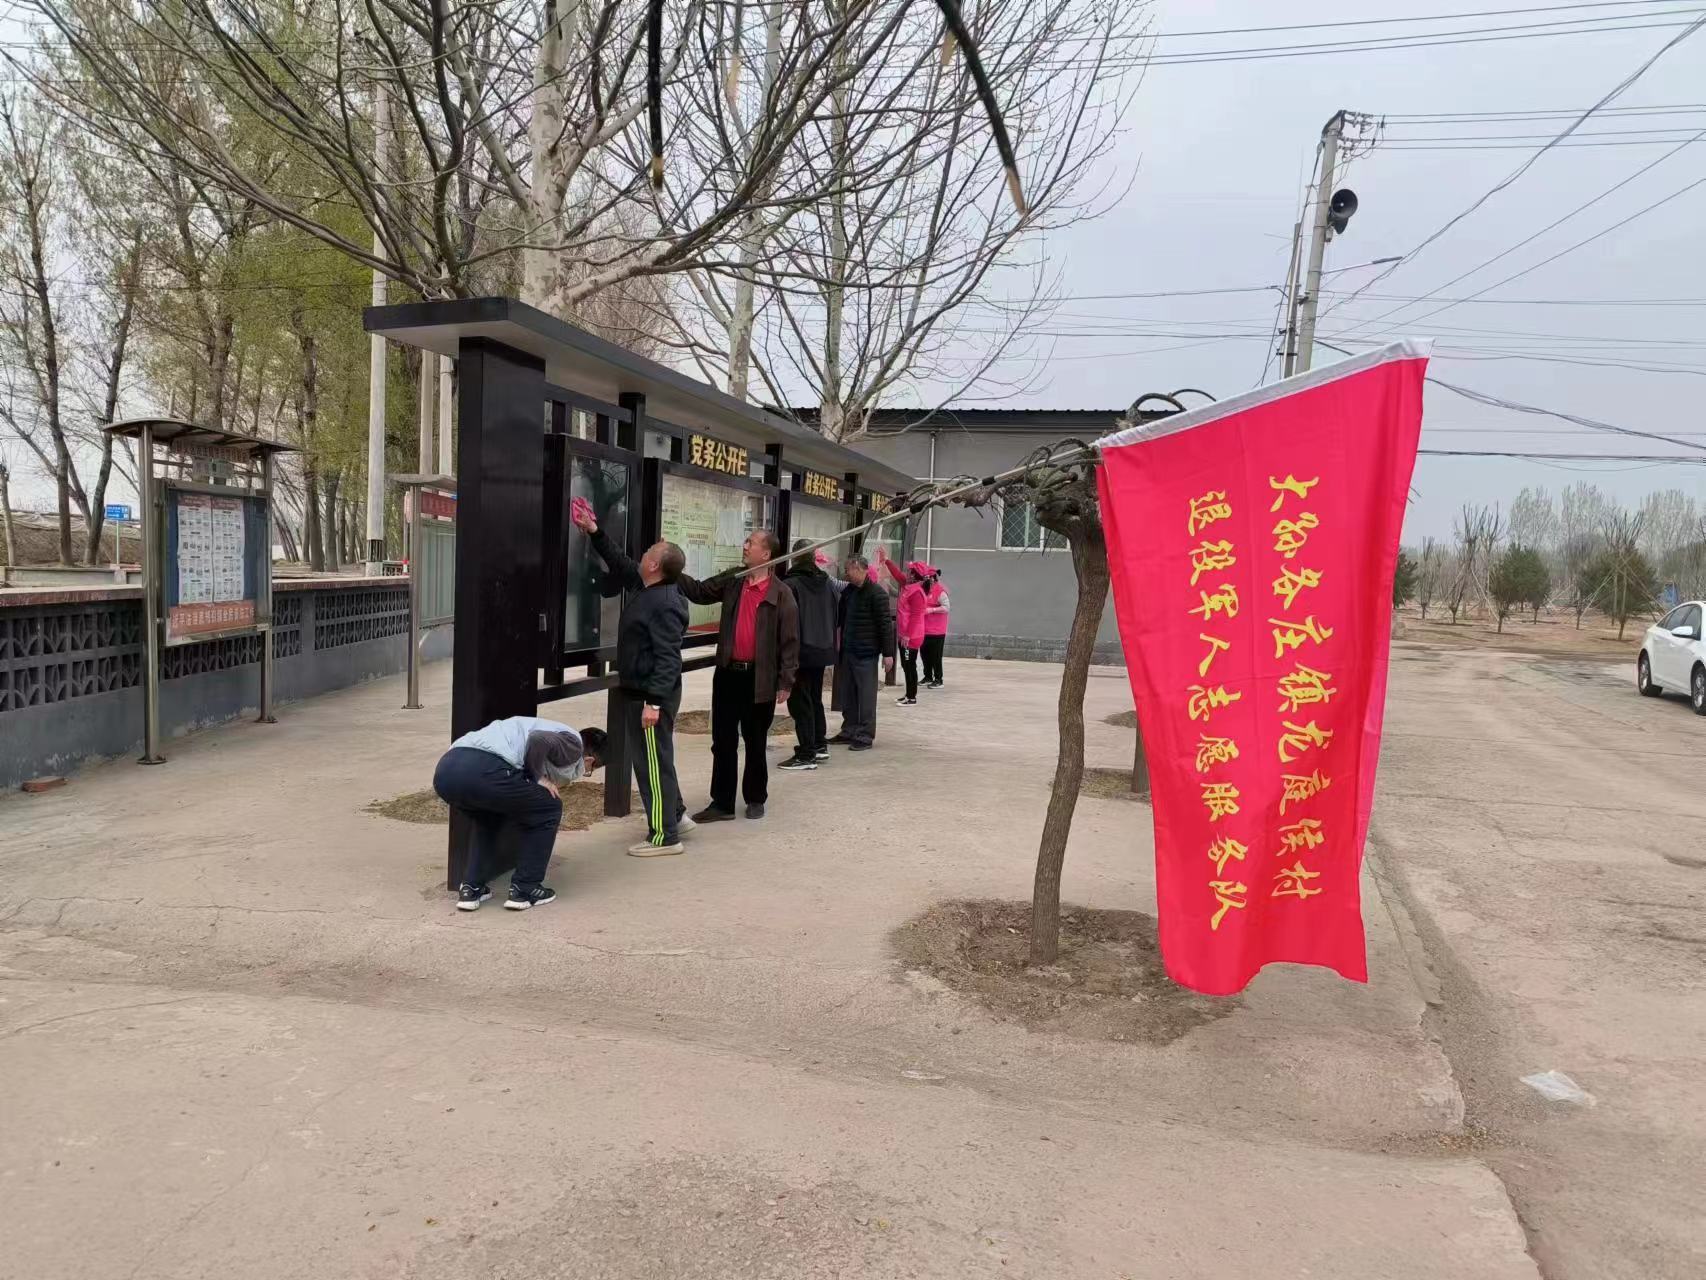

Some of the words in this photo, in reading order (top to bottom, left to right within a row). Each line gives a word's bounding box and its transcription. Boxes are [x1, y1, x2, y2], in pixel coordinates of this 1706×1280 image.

[691, 434, 748, 476] 党务公开栏
[1187, 489, 1249, 931] 退役军人志愿服务队
